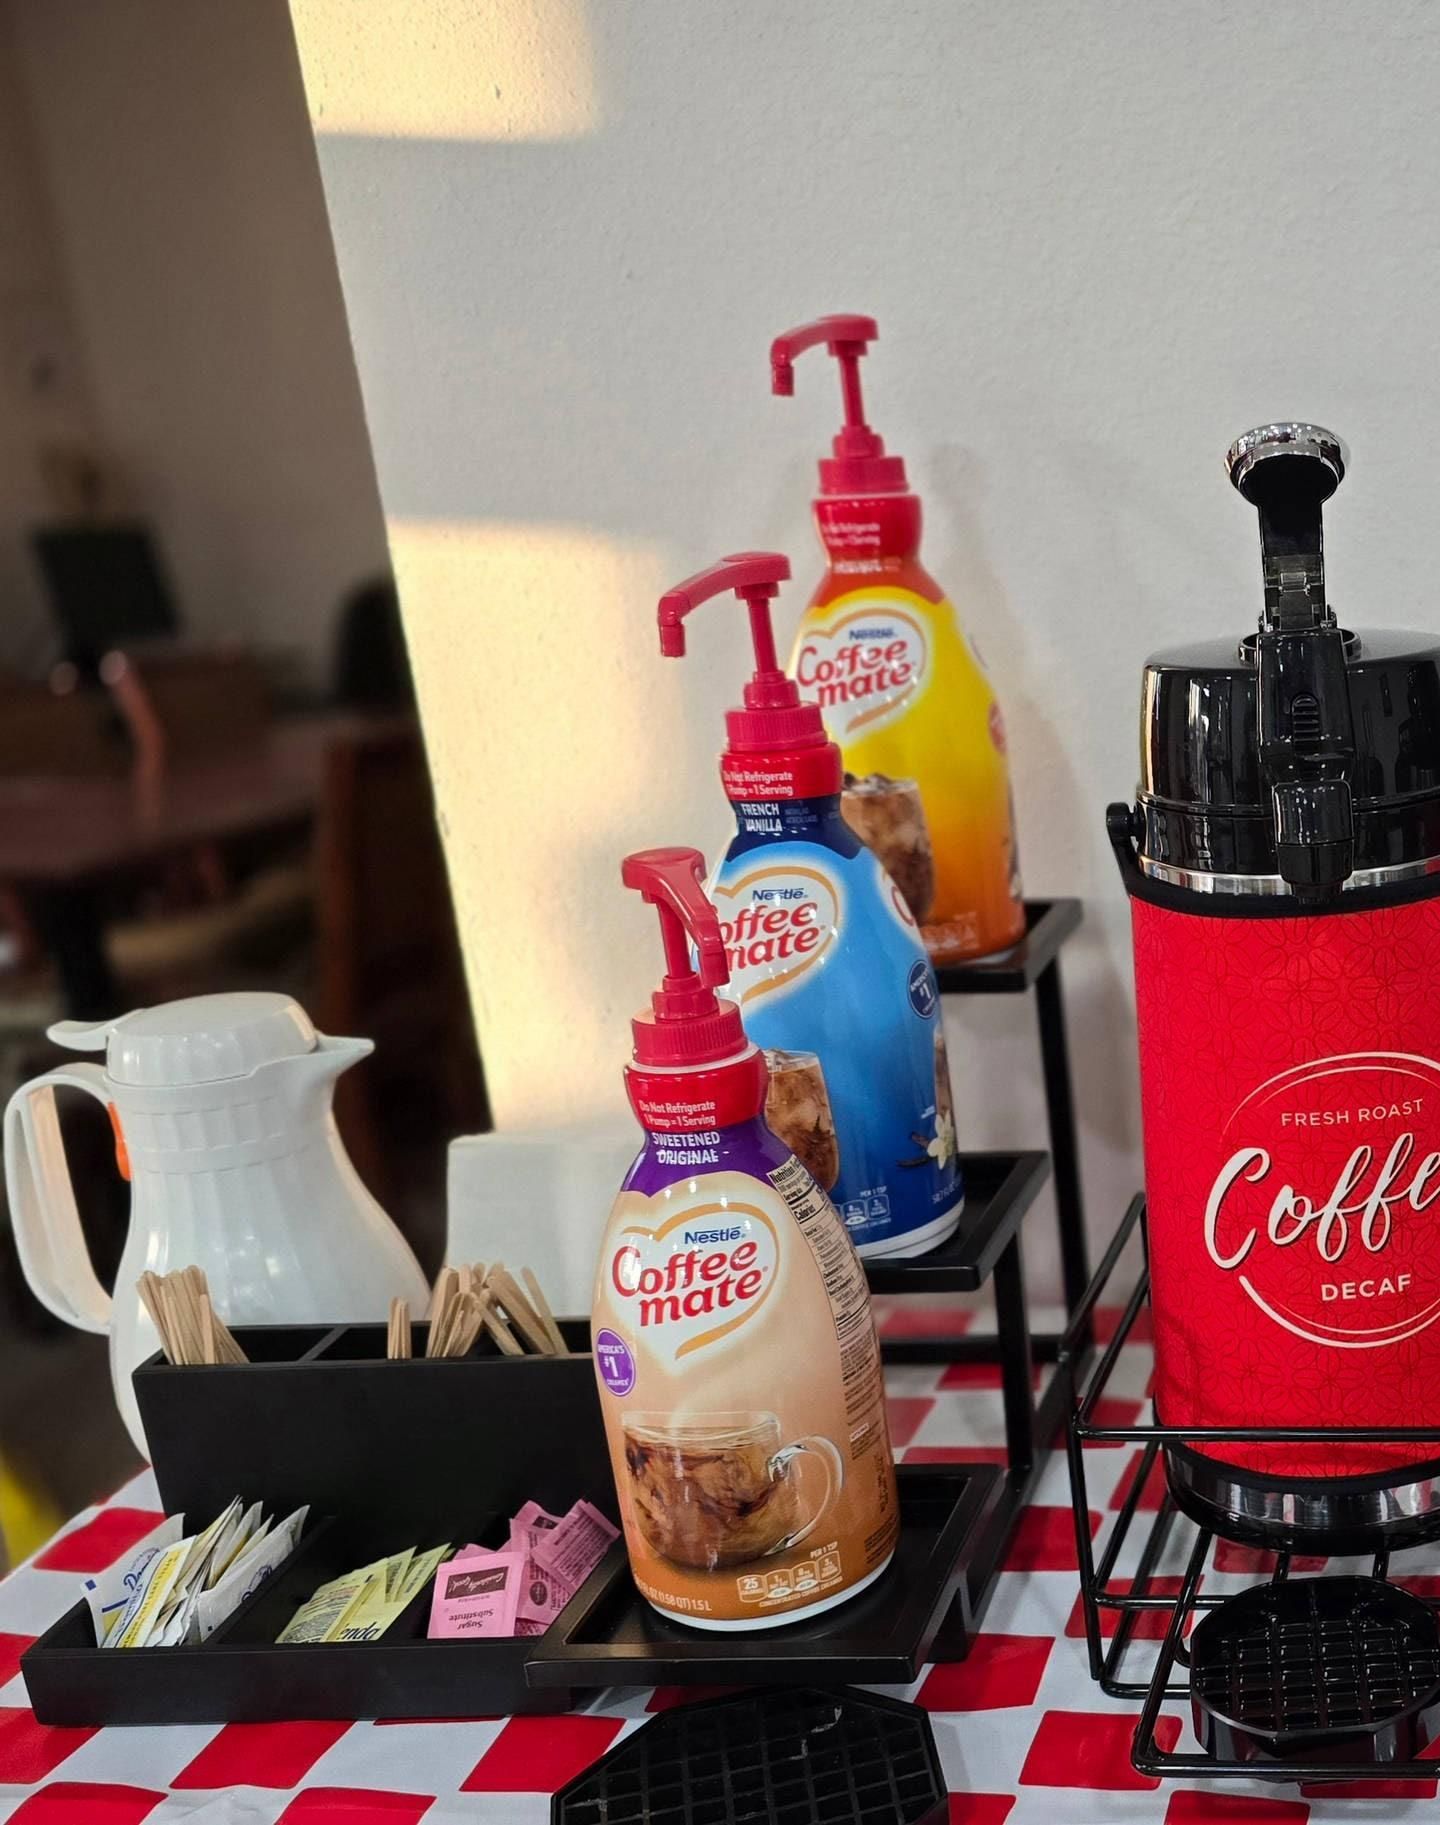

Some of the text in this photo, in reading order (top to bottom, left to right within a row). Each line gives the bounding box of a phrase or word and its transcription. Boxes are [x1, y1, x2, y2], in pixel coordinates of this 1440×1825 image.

[798, 640, 908, 687] Coffee
[817, 663, 911, 708] mate
[744, 772, 793, 784] Refrigerate
[760, 784, 794, 796] Serving
[740, 803, 780, 816] FRENCH
[745, 818, 783, 832] VANILLA
[719, 902, 818, 945] offee
[650, 1101, 665, 1113] Not
[665, 1101, 716, 1115] Refrigerate
[1281, 1098, 1423, 1126] FRESH ROAST
[649, 1114, 671, 1128] Pump
[682, 1114, 716, 1127] Serving
[651, 1131, 721, 1147] SWEETENED
[657, 1148, 719, 1165] ORIGINAL
[684, 1226, 742, 1244] Nestlé
[612, 1241, 758, 1297] Coffee
[1321, 1273, 1412, 1302] DECAF
[639, 1269, 762, 1327] mate
[604, 1354, 619, 1378] #1
[743, 1577, 759, 1590] 25
[704, 1600, 713, 1612] L
[448, 1608, 494, 1622] Substitute
[456, 1620, 483, 1631] Sugar
